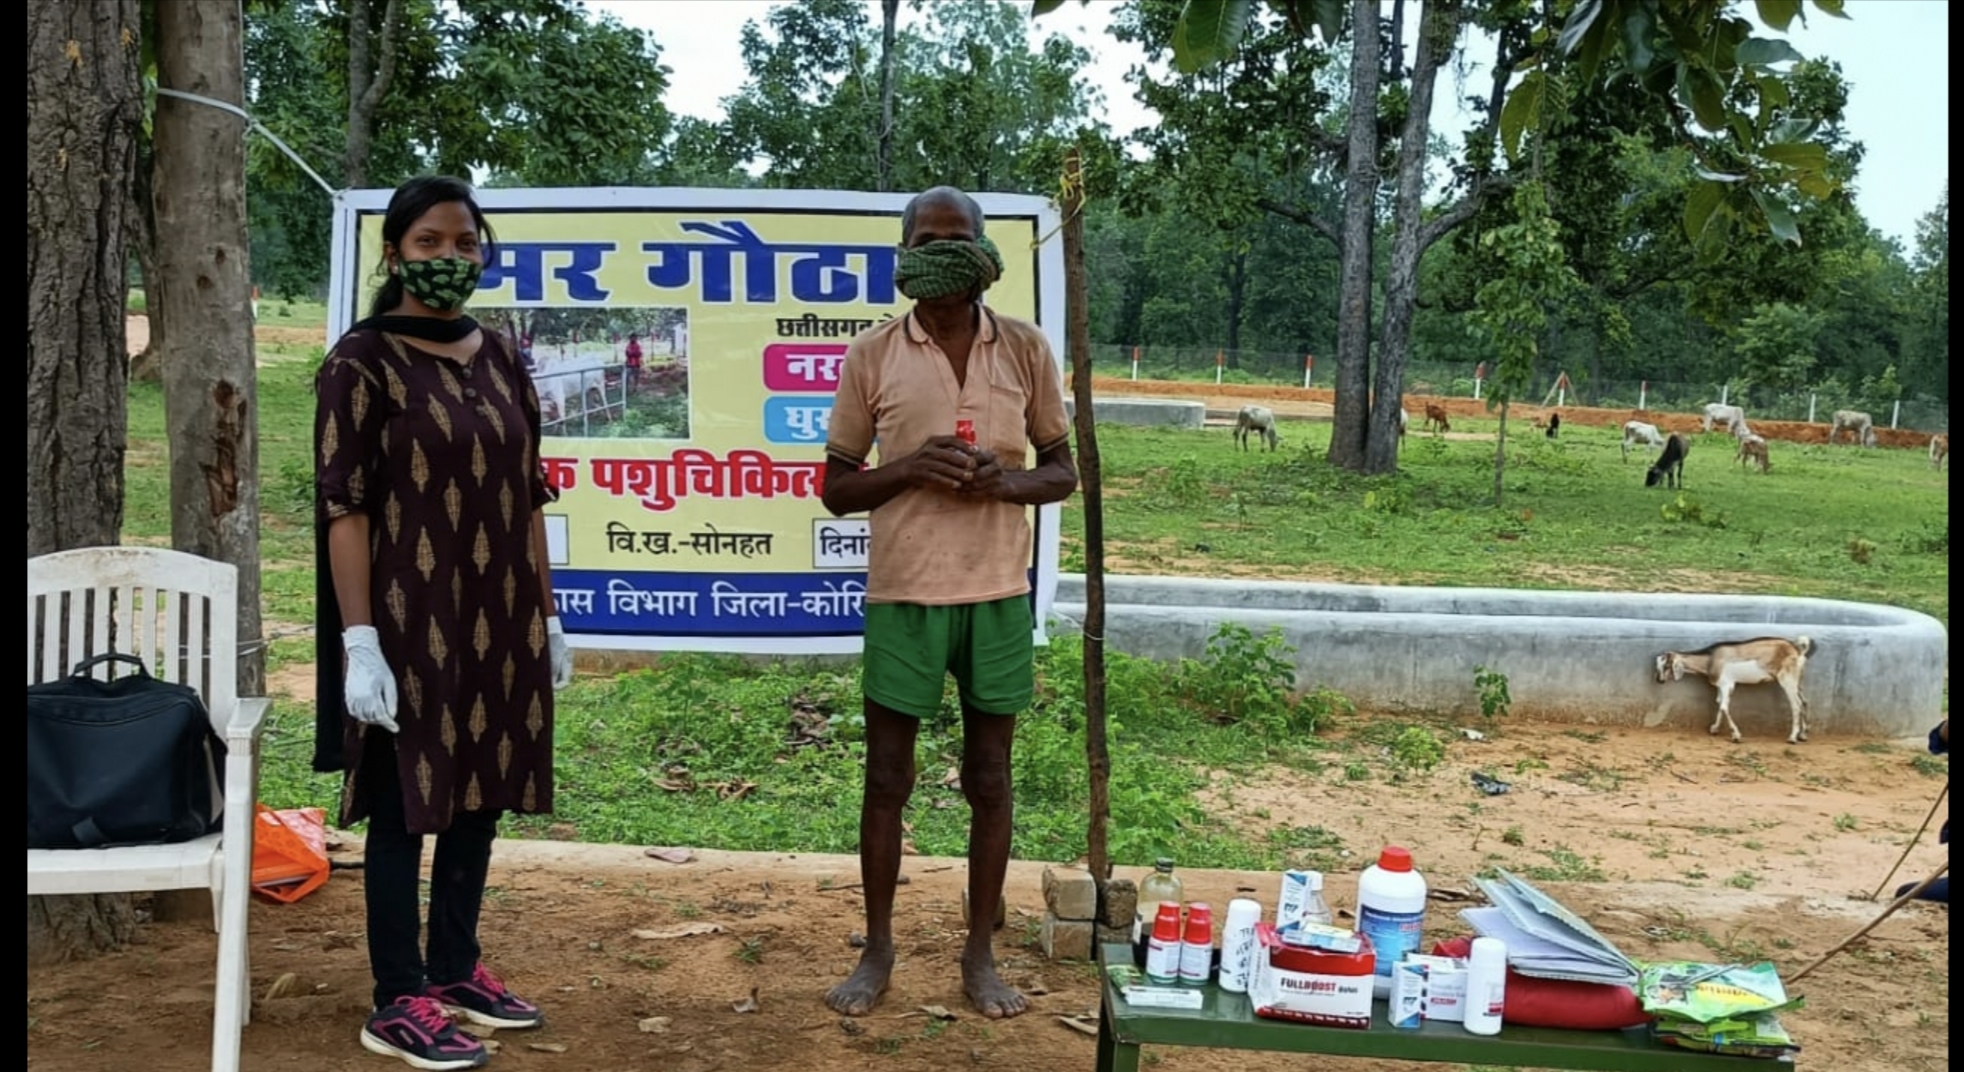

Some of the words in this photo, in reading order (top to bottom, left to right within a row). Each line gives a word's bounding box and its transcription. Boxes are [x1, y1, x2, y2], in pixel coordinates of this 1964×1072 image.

[477, 243, 616, 301] मर
[643, 220, 897, 304] गौठा
[785, 354, 844, 381] नर
[820, 526, 871, 559] दिनां
[552, 588, 595, 616] ास
[606, 579, 699, 617] विभाग
[711, 580, 867, 617] जिला-कोरि
